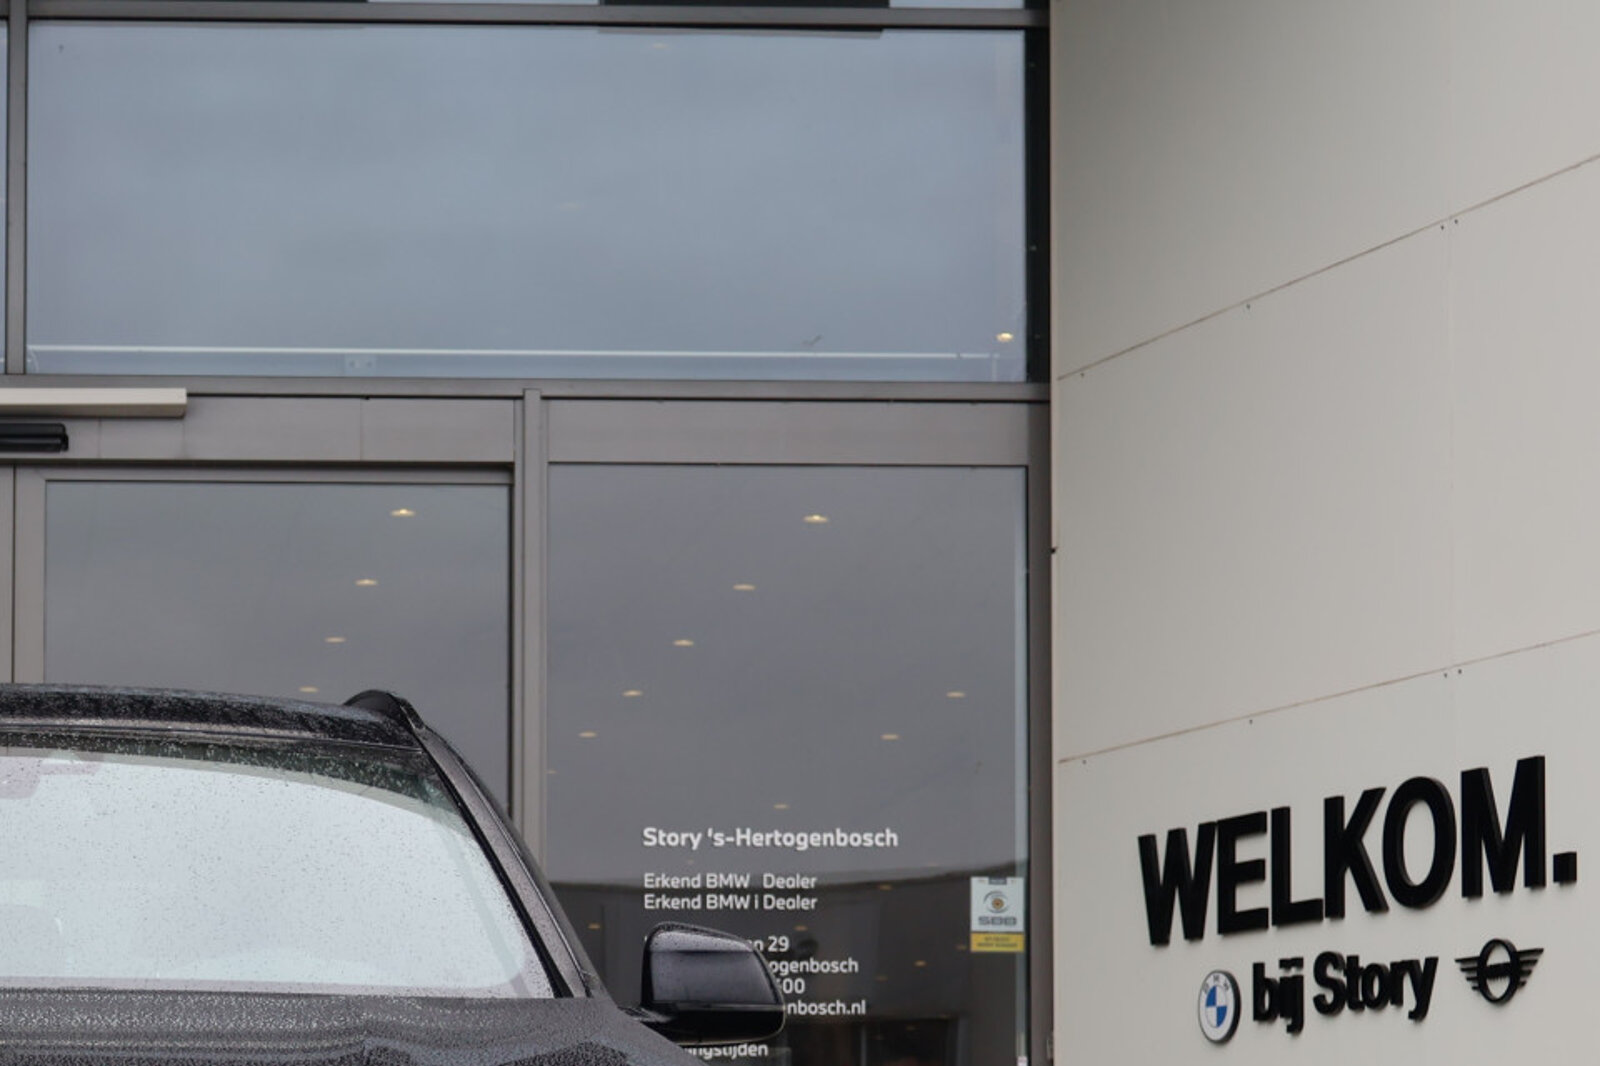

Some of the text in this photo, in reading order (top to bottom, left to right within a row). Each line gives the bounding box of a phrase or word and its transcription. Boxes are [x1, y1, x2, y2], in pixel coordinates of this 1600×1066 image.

[643, 827, 899, 851] Story 's-Hertogenbosch
[1138, 755, 1578, 946] WELKOM.
[643, 872, 817, 889] Erkend BMW Dealer
[643, 893, 701, 910] Erkend
[706, 893, 751, 910] BMW
[762, 893, 817, 910] Dealer
[767, 936, 790, 952] 29
[768, 957, 859, 976] ogenbosch
[1252, 950, 1439, 1034] bij Story
